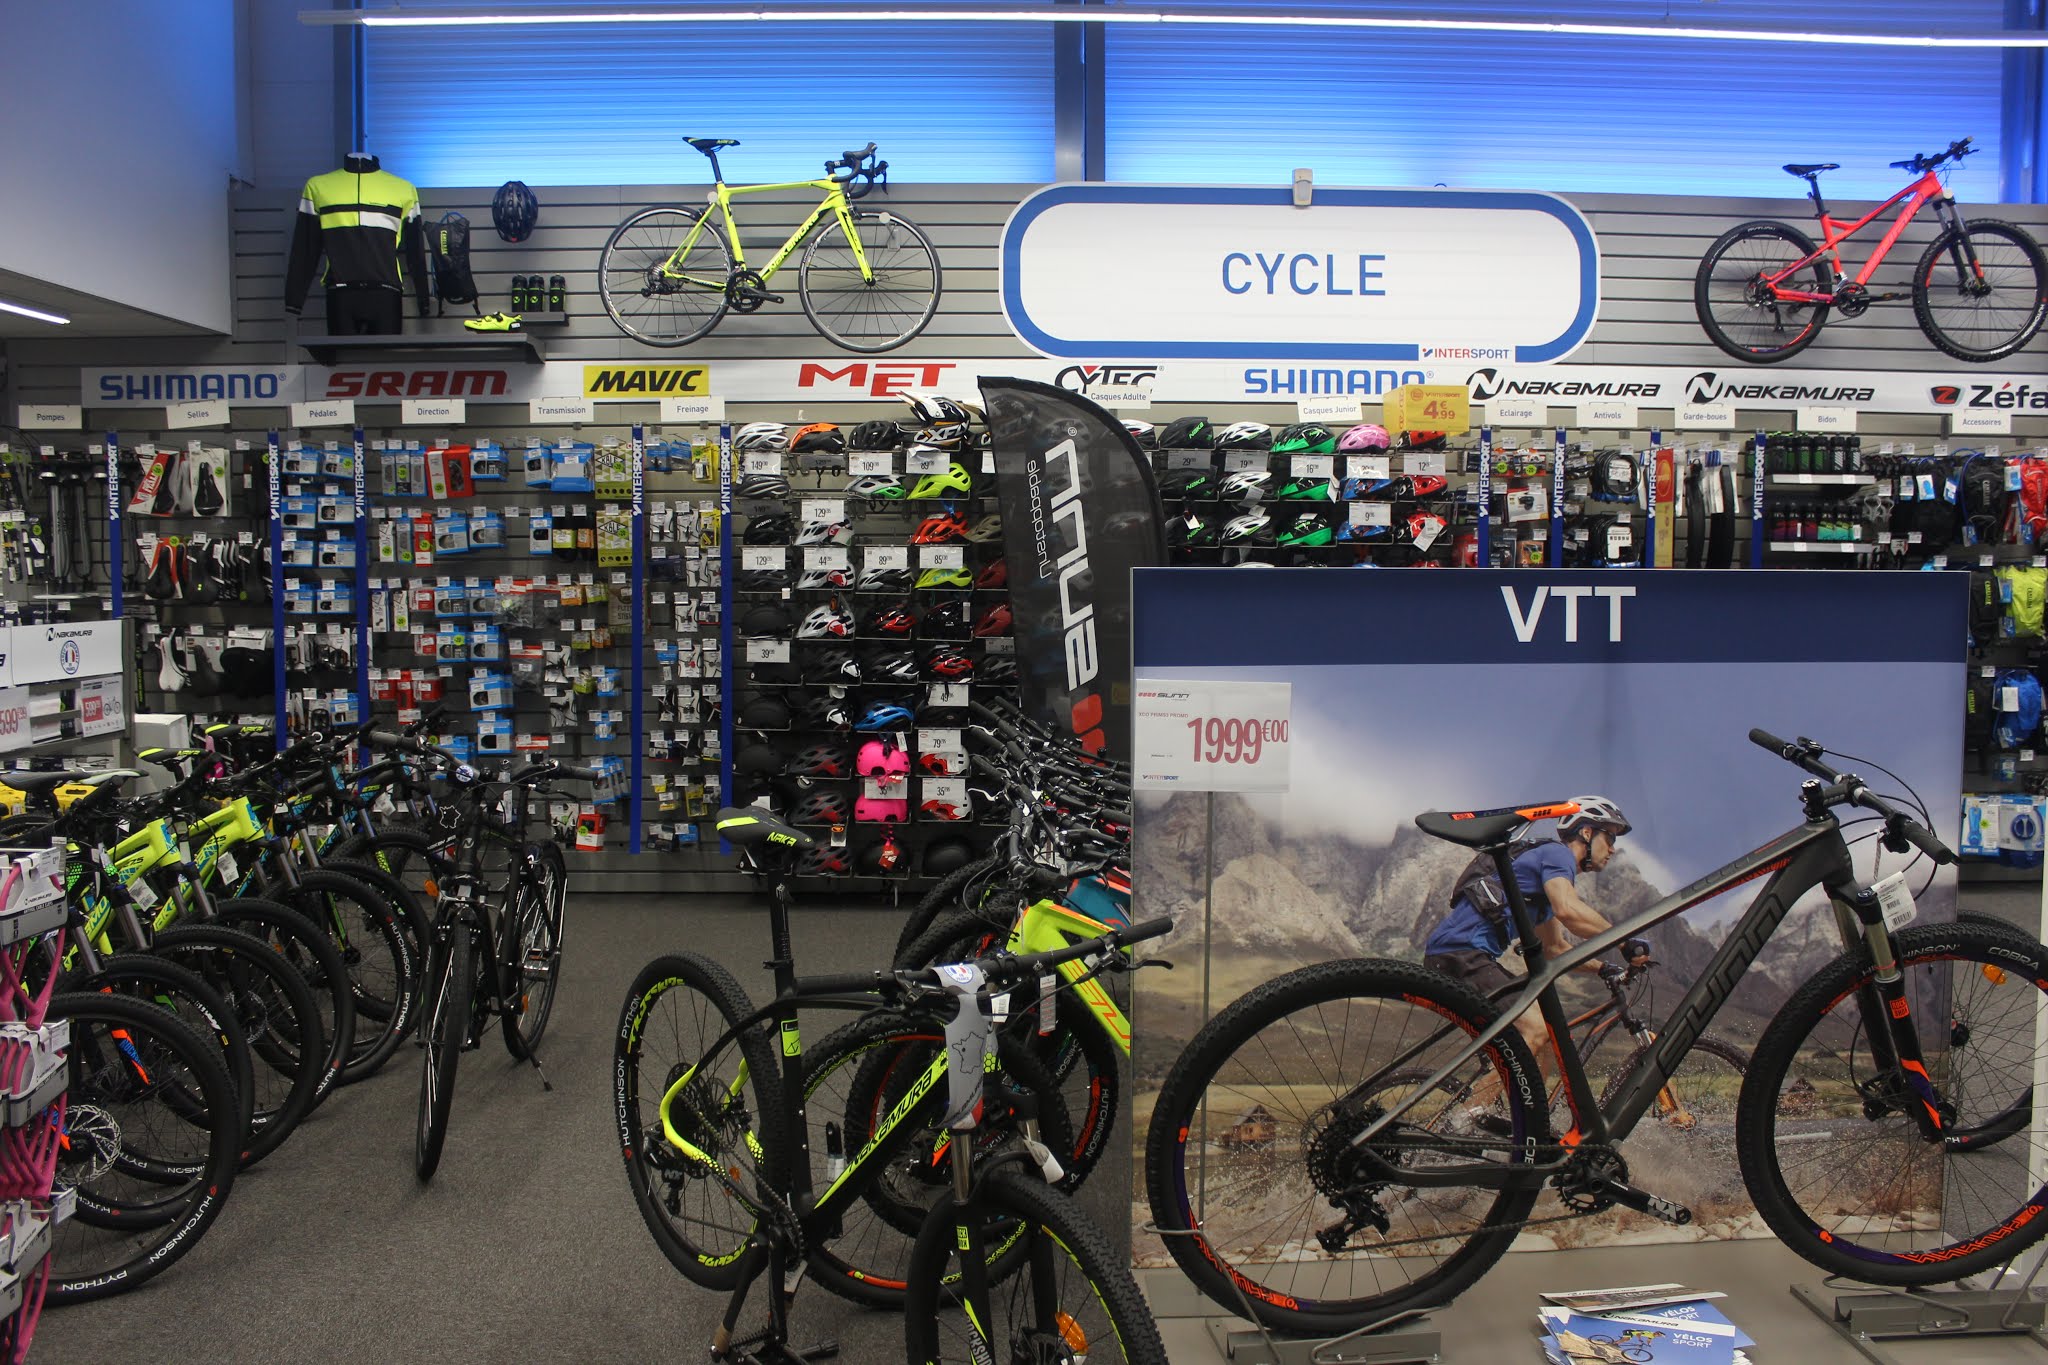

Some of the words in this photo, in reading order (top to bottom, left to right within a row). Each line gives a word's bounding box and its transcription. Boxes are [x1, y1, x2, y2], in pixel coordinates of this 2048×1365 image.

[1221, 252, 1386, 297] CYCLE
[1434, 347, 1509, 360] INTERSPORT
[100, 373, 278, 400] SHIMANO
[325, 370, 509, 397] SRAM
[589, 369, 703, 392] MAVIC
[797, 363, 957, 397] MET
[1244, 368, 1425, 394] SHIMANO
[1504, 380, 1661, 398] NAKAMURA
[1090, 392, 1120, 402] Casques
[1121, 392, 1147, 401] Adulte
[1724, 383, 1875, 401] NAKAMURA
[36, 413, 65, 423] Pompes
[187, 409, 209, 419] Selles
[309, 407, 338, 418] Pédales
[417, 406, 450, 416] Direction
[537, 405, 586, 415] Transmission
[676, 404, 709, 415] Freinage
[1303, 405, 1331, 415] Casques
[1332, 405, 1357, 413] Junior
[1499, 408, 1533, 419] Eclairage
[1593, 411, 1622, 420] Antivols
[1683, 411, 1727, 421] Garde-boues
[1817, 415, 1838, 424] Bidon
[1962, 417, 2002, 427] Accessoires
[107, 442, 120, 509] INTERSPORT
[268, 442, 280, 508] INTERSPORT
[353, 441, 365, 507] INTERSPORT
[632, 438, 643, 504] INTERSPORT
[720, 437, 731, 503] INTERSPORT
[1479, 440, 1491, 506] INTERSPORT
[1553, 441, 1566, 507] INTERSPORT
[1753, 445, 1765, 510] INTERSPORT
[1500, 586, 1637, 642] VTT
[56, 629, 93, 639] NAKAMURA
[767, 832, 797, 847] NAKA
[389, 921, 411, 978] HUTCHINSON
[1988, 946, 2039, 971] COBRA
[395, 992, 411, 1030] PYTHON
[621, 994, 642, 1039] PYTHON
[869, 1027, 918, 1040] TAIPAN
[803, 1051, 843, 1088] HINSON
[617, 1059, 630, 1146] HUTCHINSON
[849, 1068, 933, 1173] NAKAMURA
[1086, 1088, 1108, 1157] HUTCHINSON
[119, 1151, 148, 1169] PYTH
[149, 1195, 214, 1264] HUTCHINSON
[62, 1270, 128, 1292] PYTHON
[1612, 1314, 1679, 1327] NAKAMURA
[1660, 1306, 1696, 1318] VÉLOS
[1672, 1338, 1712, 1349] SPORT
[1673, 1332, 1713, 1343] VÉLOS
